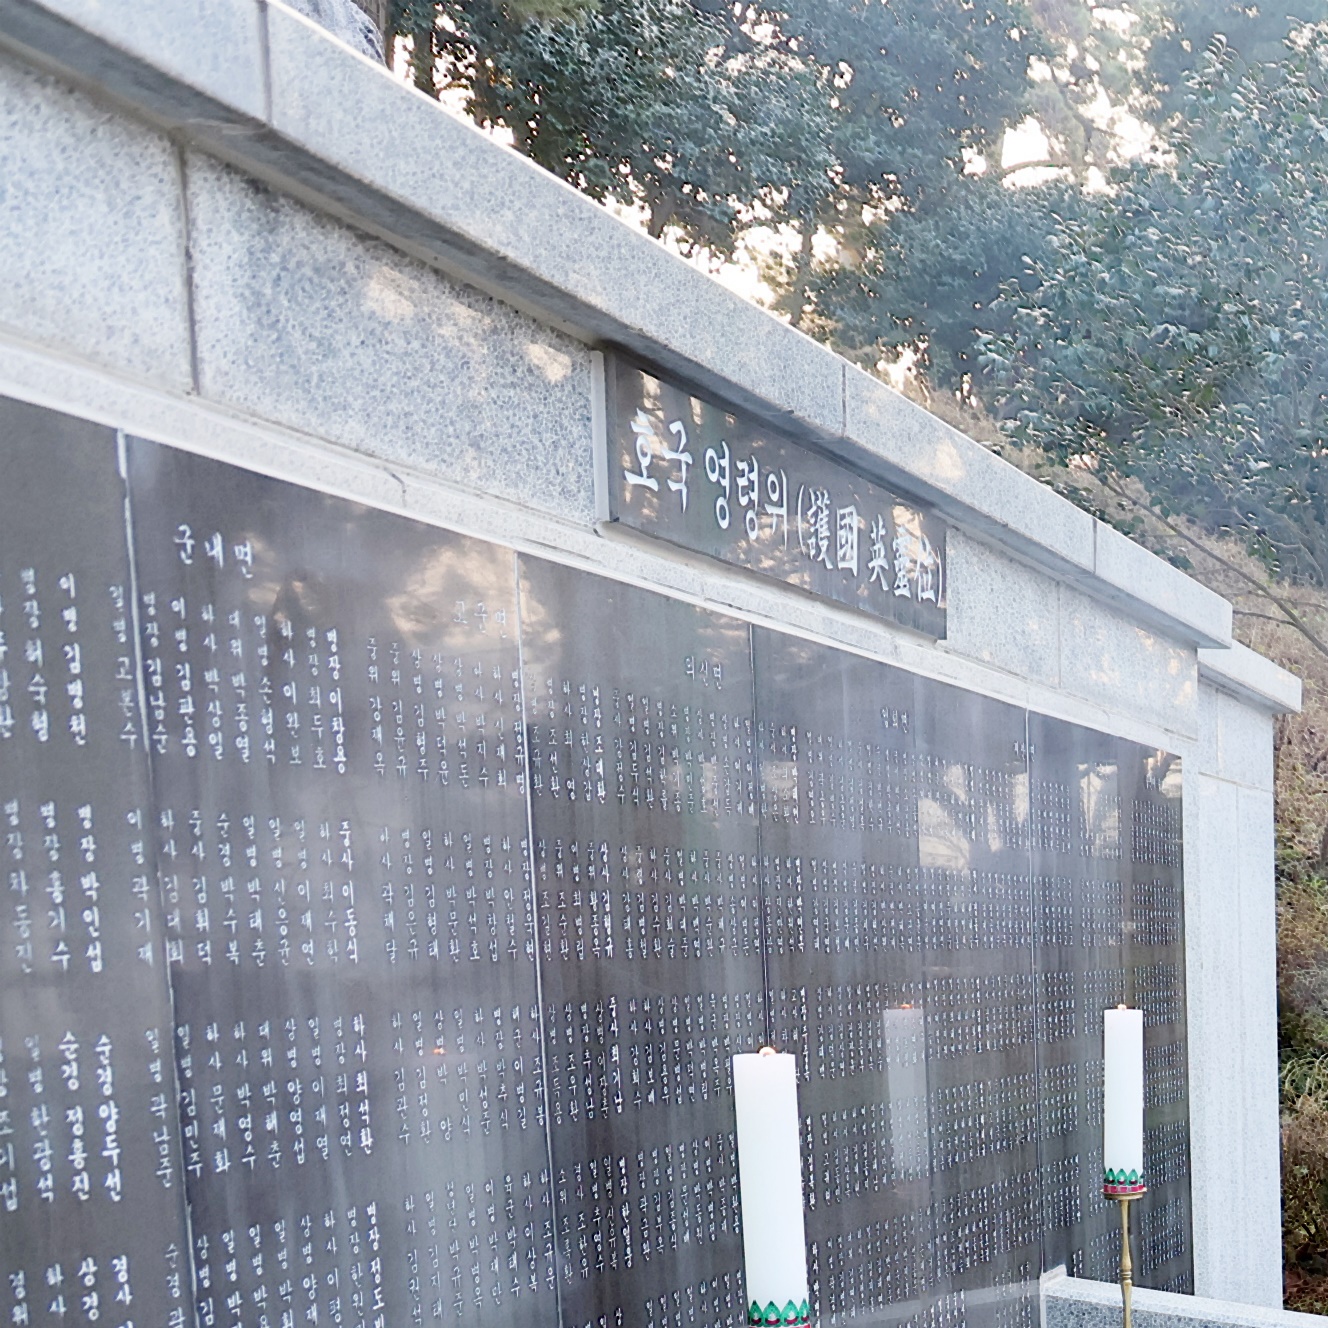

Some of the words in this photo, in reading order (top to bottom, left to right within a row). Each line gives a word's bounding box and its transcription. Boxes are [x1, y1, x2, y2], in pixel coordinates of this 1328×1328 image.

[624, 408, 694, 514] 호국
[704, 440, 789, 550] 영령위
[173, 524, 254, 579] 군내면
[20, 567, 40, 629] 병장
[142, 591, 160, 648] 병장
[453, 600, 508, 638] 고군면
[170, 596, 188, 653] 이병
[200, 603, 218, 653] 하사
[228, 609, 243, 659] 대위
[305, 626, 320, 677] 병장
[326, 628, 342, 681] 병장
[389, 642, 401, 686] 중위
[685, 656, 722, 690] 의신면
[39, 801, 60, 862] 병장
[77, 804, 97, 863] 병장
[216, 812, 232, 868] 순경
[242, 814, 258, 868] 일병
[338, 820, 354, 872] 중사
[462, 833, 474, 878] 일병
[502, 835, 513, 875] 하사
[58, 1030, 80, 1091] 순경
[206, 1022, 222, 1071] 하사
[233, 1020, 249, 1068] 하사
[285, 1017, 298, 1068] 상병
[307, 1016, 322, 1066] 일병
[236, 1082, 257, 1170] 박영수
[300, 1214, 313, 1265] 상병
[346, 1205, 361, 1255] 병장
[366, 1201, 381, 1252] 병장
[424, 1190, 437, 1237] 일병
[221, 1228, 238, 1282] 일병
[248, 1223, 264, 1277] 일병
[8, 1270, 29, 1326] 경위
[111, 1254, 133, 1306] 경사
